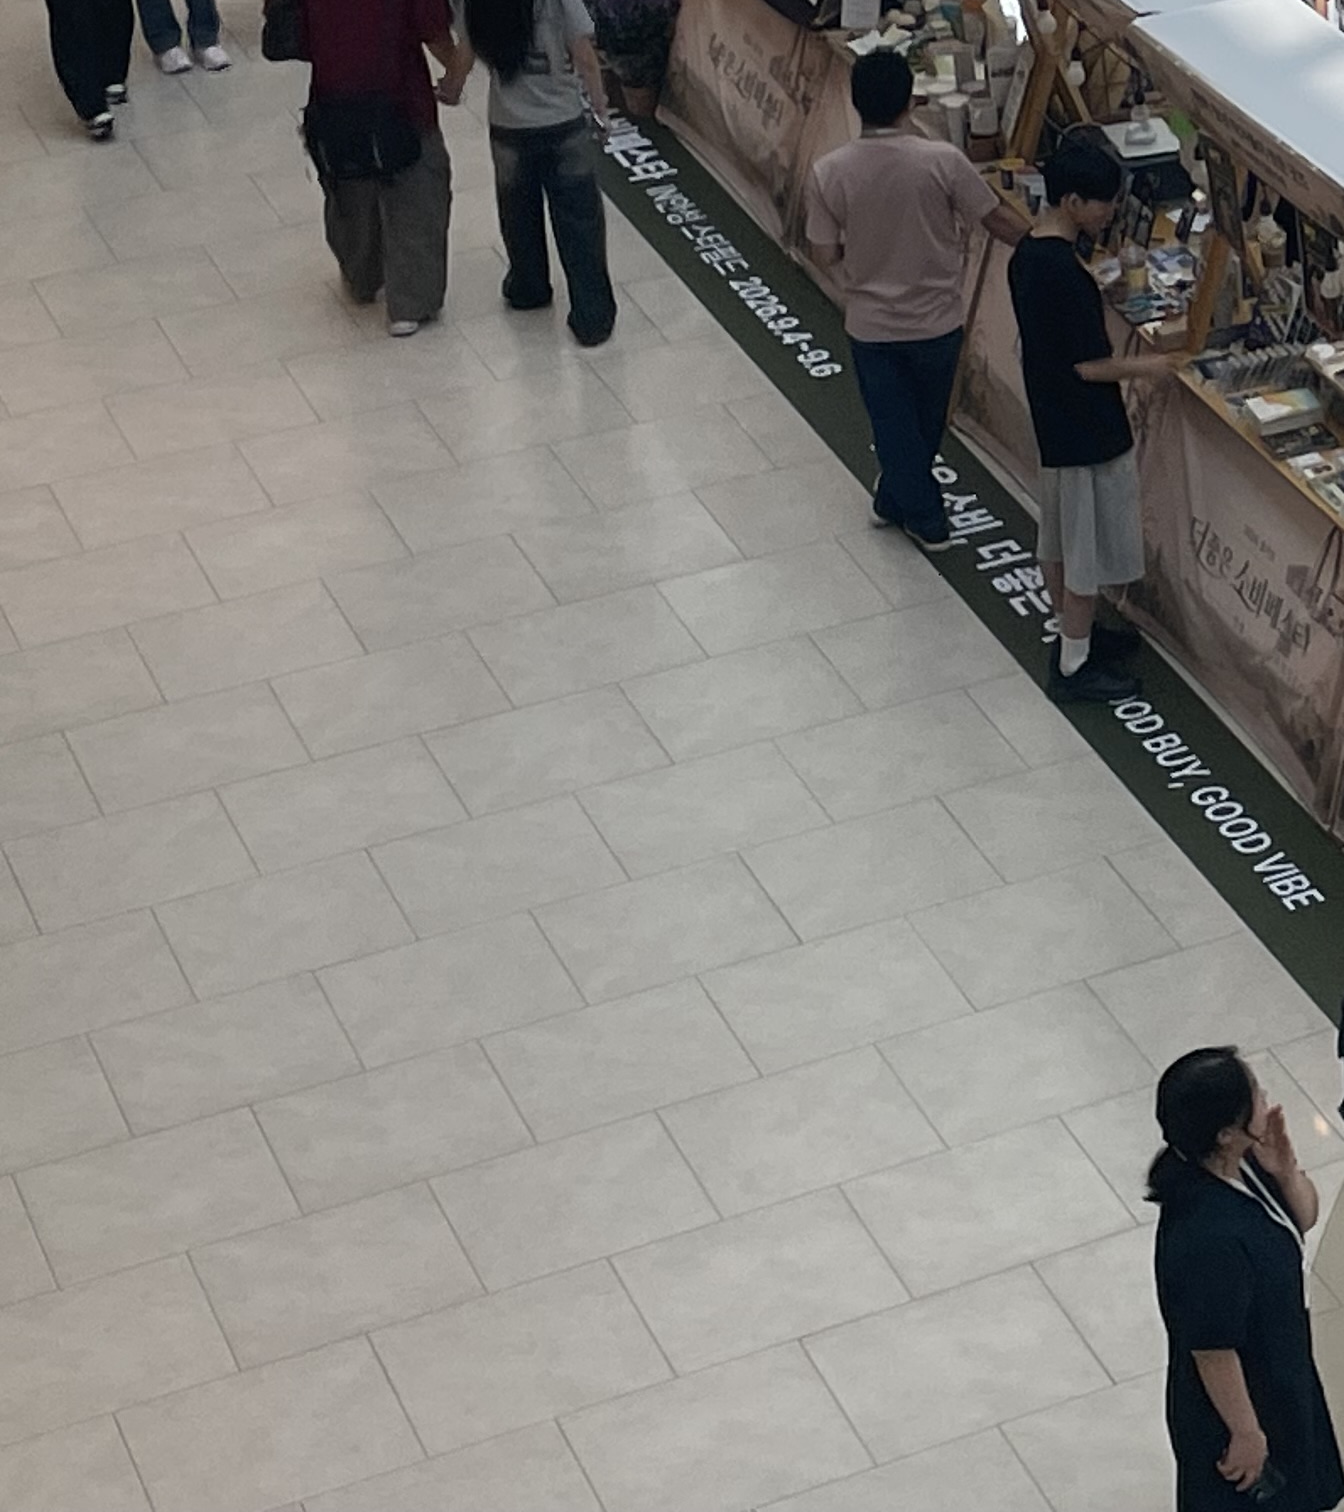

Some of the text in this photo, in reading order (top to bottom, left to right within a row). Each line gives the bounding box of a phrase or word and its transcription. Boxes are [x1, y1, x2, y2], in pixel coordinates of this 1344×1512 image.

[603, 107, 678, 182] 비페스타
[976, 539, 1033, 571] 더
[1142, 733, 1211, 788] BUY,
[1191, 786, 1272, 854] GOOD
[1253, 852, 1325, 911] VIBE
